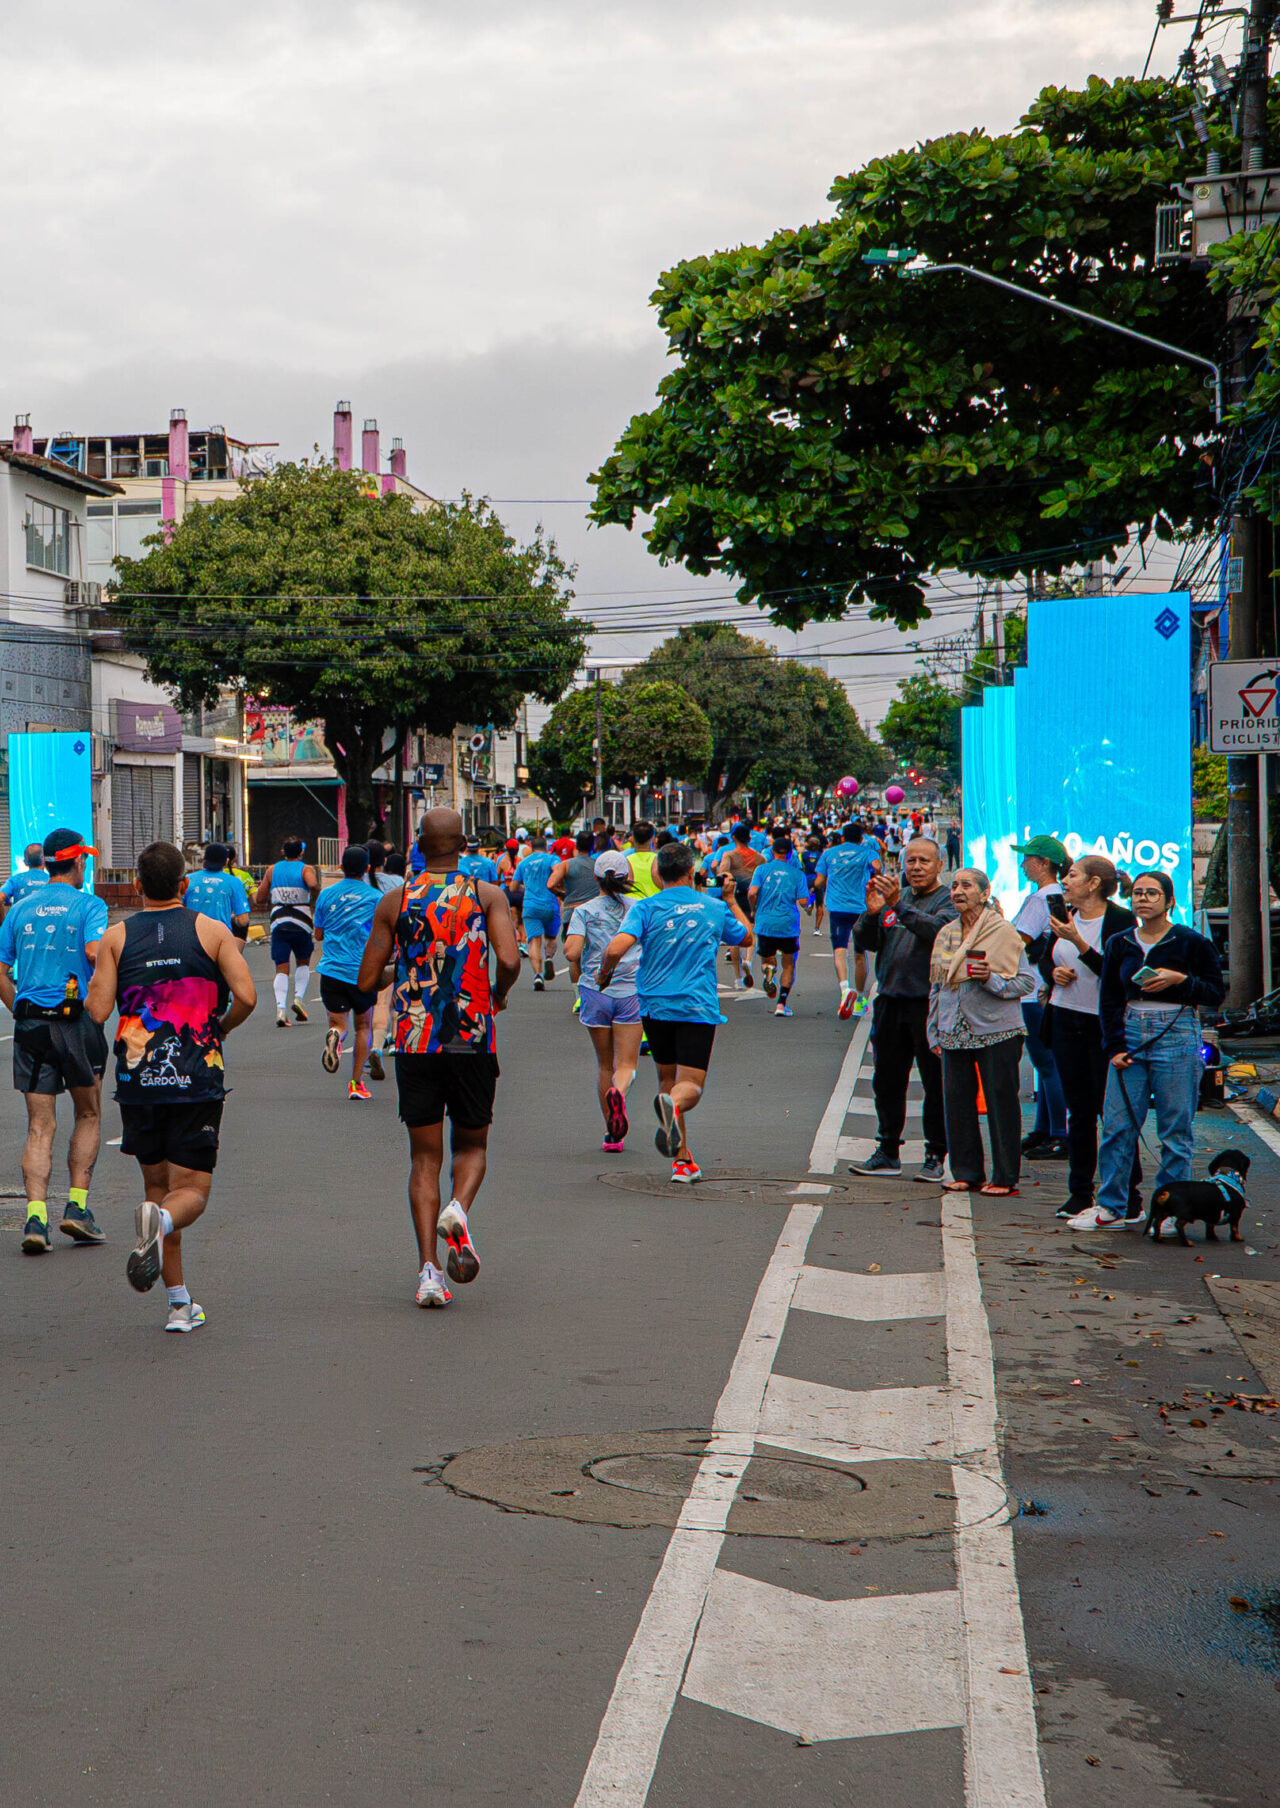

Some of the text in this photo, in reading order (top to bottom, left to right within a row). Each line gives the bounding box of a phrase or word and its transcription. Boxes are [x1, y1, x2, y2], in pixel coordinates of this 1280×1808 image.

[1220, 719, 1280, 729] PRIORID
[1093, 832, 1180, 869] AÑOS
[146, 958, 181, 967] STEVEN
[140, 1076, 192, 1087] CARDONA
